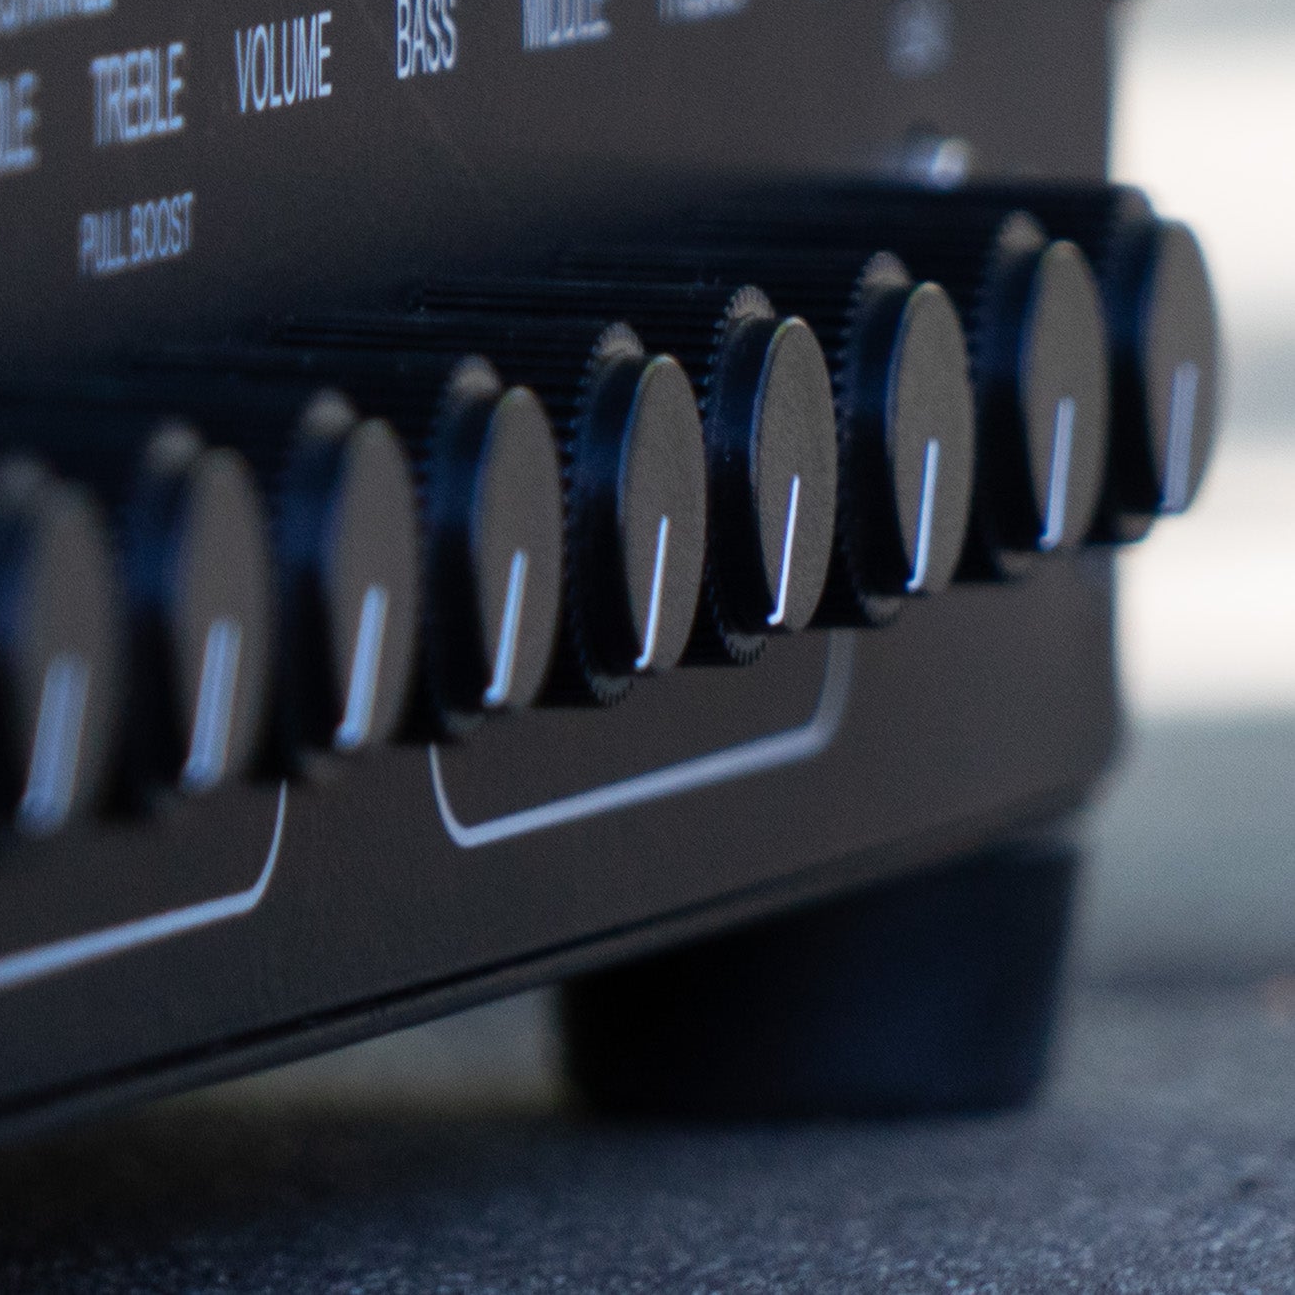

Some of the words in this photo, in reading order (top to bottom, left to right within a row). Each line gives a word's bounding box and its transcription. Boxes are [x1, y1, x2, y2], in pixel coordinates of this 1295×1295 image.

[90, 41, 186, 148] TREBLE
[234, 9, 333, 114] VOLUME
[77, 210, 129, 280] PULL
[130, 190, 195, 268] BOOST
